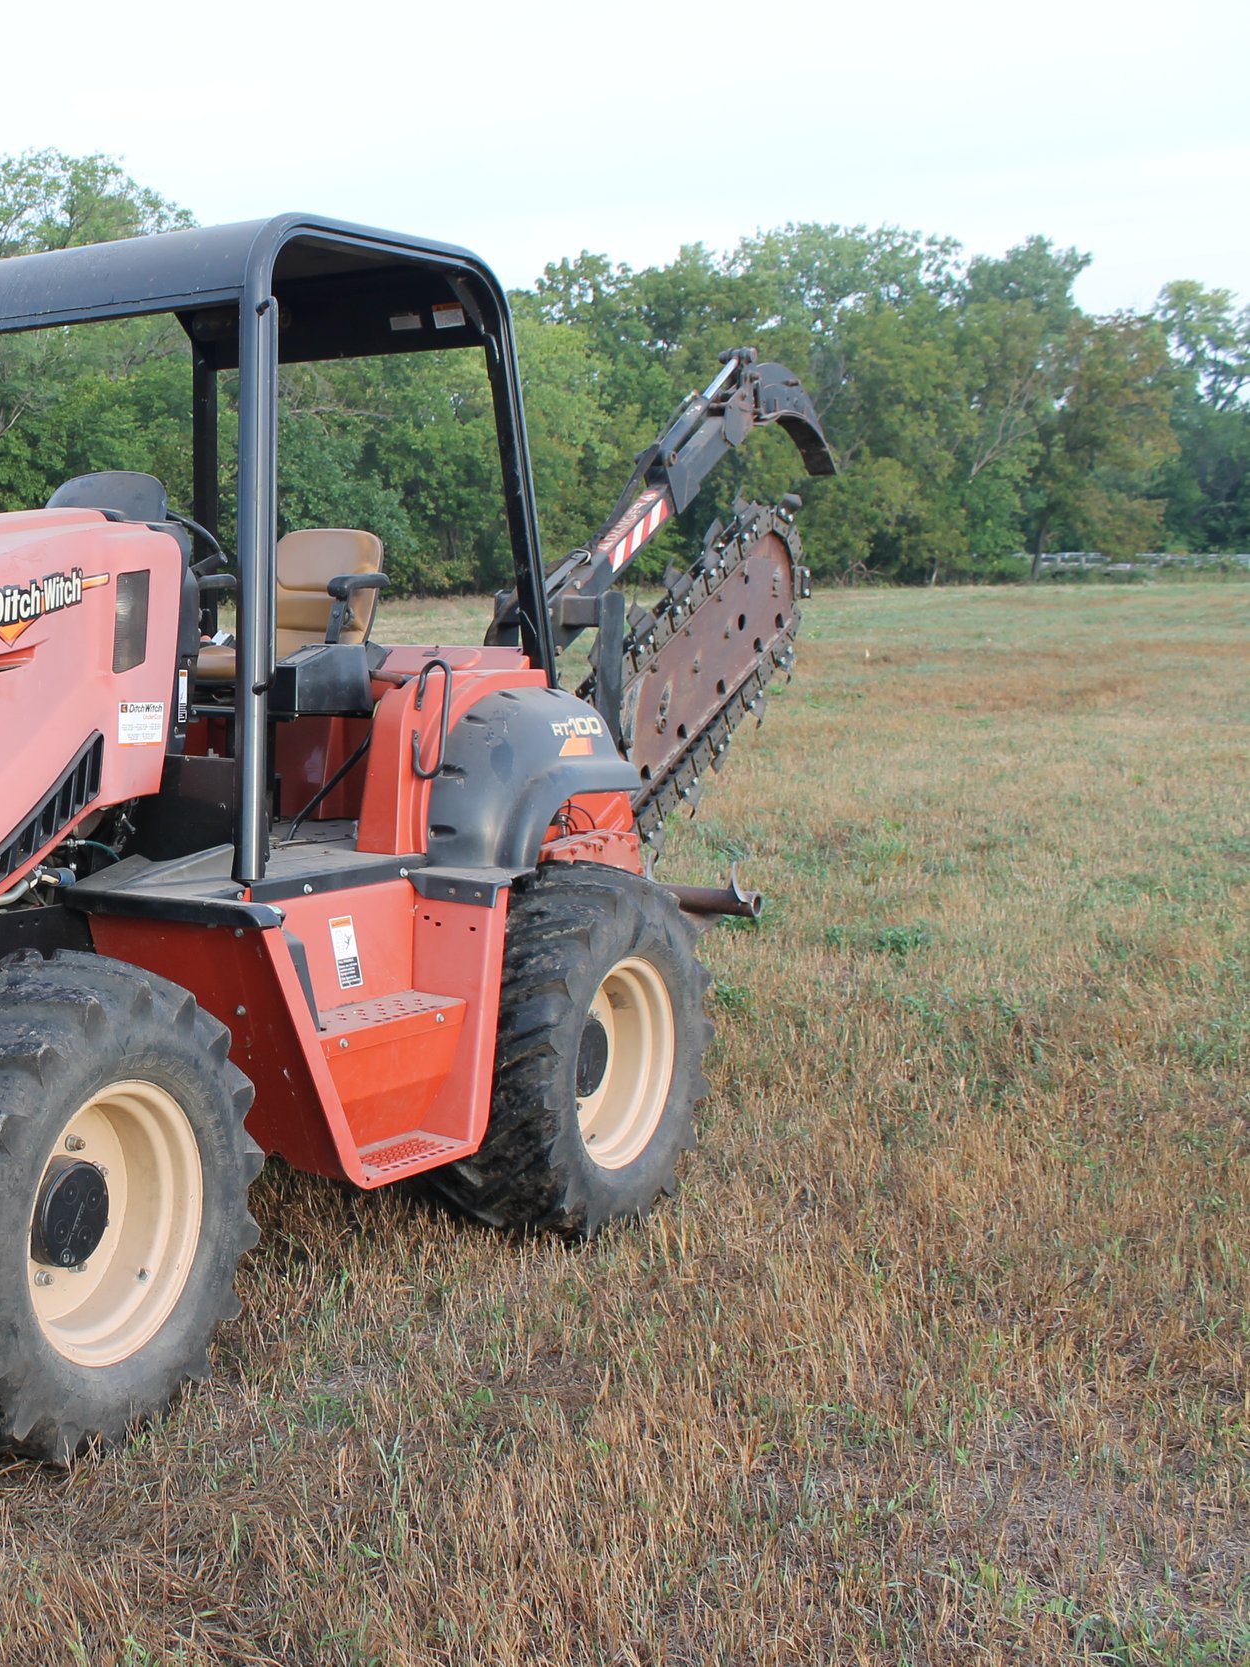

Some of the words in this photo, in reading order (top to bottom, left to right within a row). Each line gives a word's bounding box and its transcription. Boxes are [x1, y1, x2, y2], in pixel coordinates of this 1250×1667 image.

[604, 502, 648, 541] DANGER
[43, 571, 82, 611] Witch
[129, 703, 144, 713] Ditch
[145, 703, 162, 713] Witch
